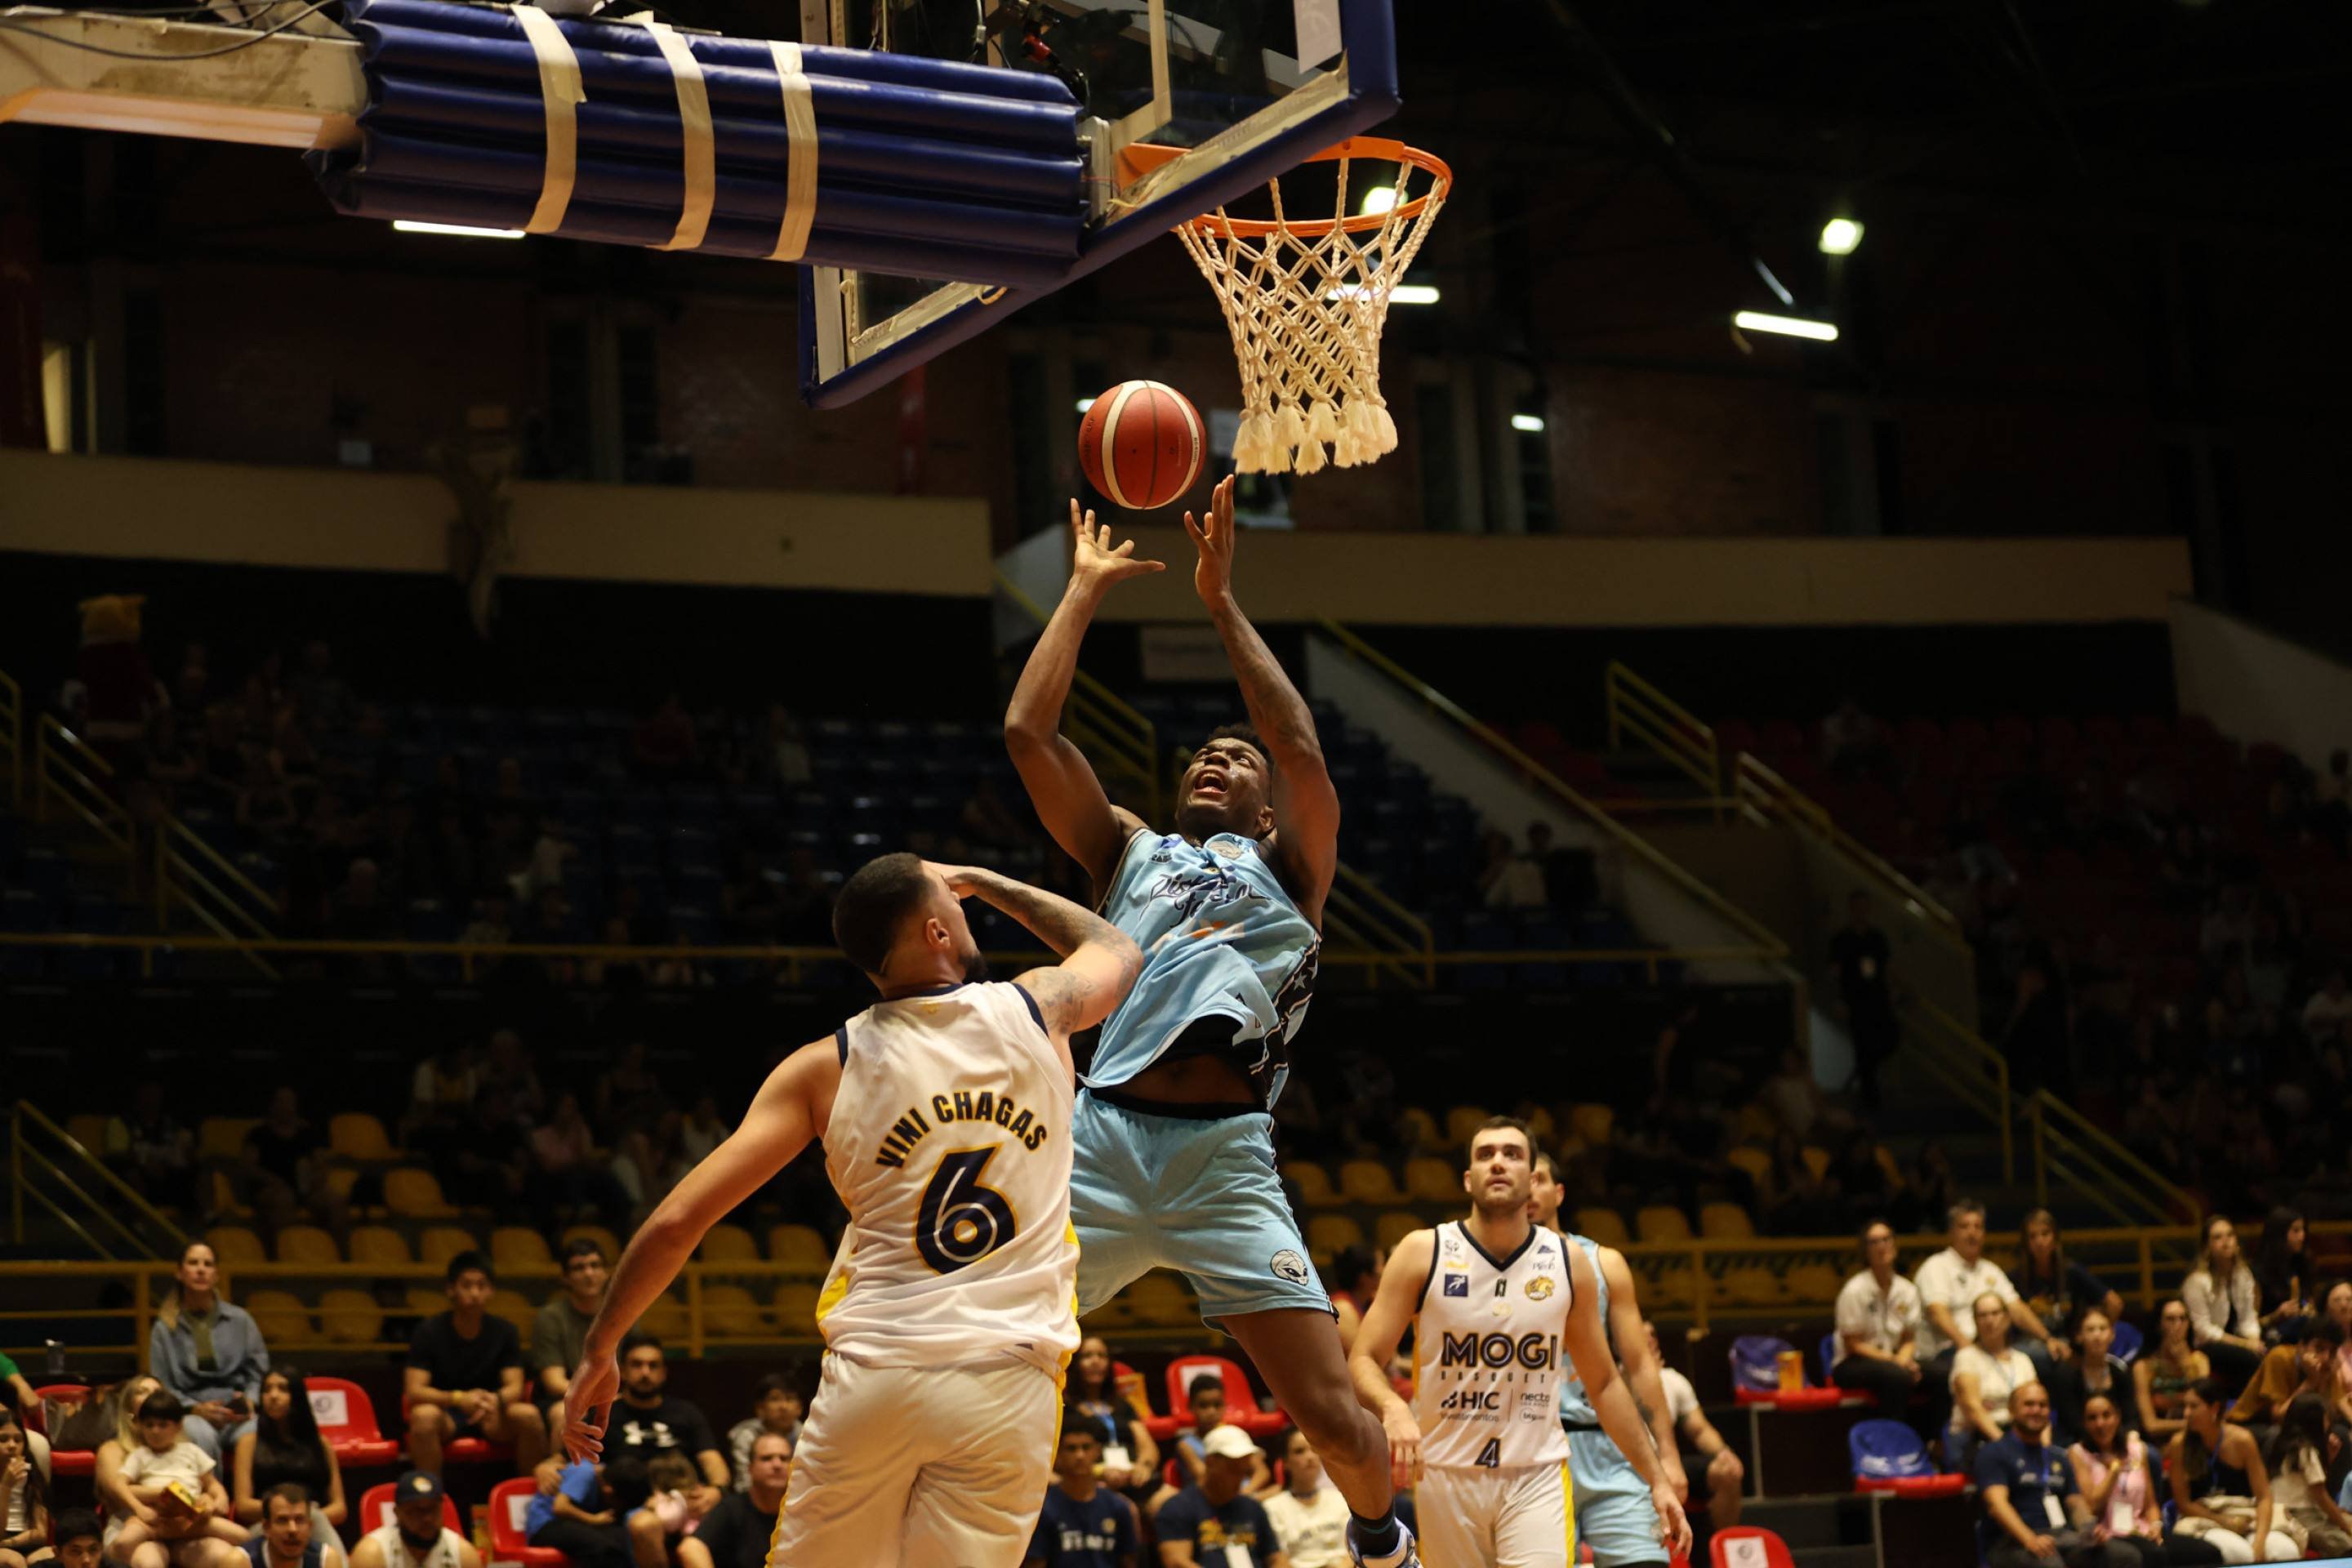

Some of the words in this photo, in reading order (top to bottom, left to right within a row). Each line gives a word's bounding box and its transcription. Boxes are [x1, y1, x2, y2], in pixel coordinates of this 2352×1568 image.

[876, 1108, 931, 1169] VINI
[932, 1091, 1048, 1151] CHAGAS
[915, 1144, 1018, 1275] 6
[1441, 1332, 1557, 1370] MOGI
[1461, 1392, 1500, 1410] HIC
[1474, 1437, 1501, 1468] 4
